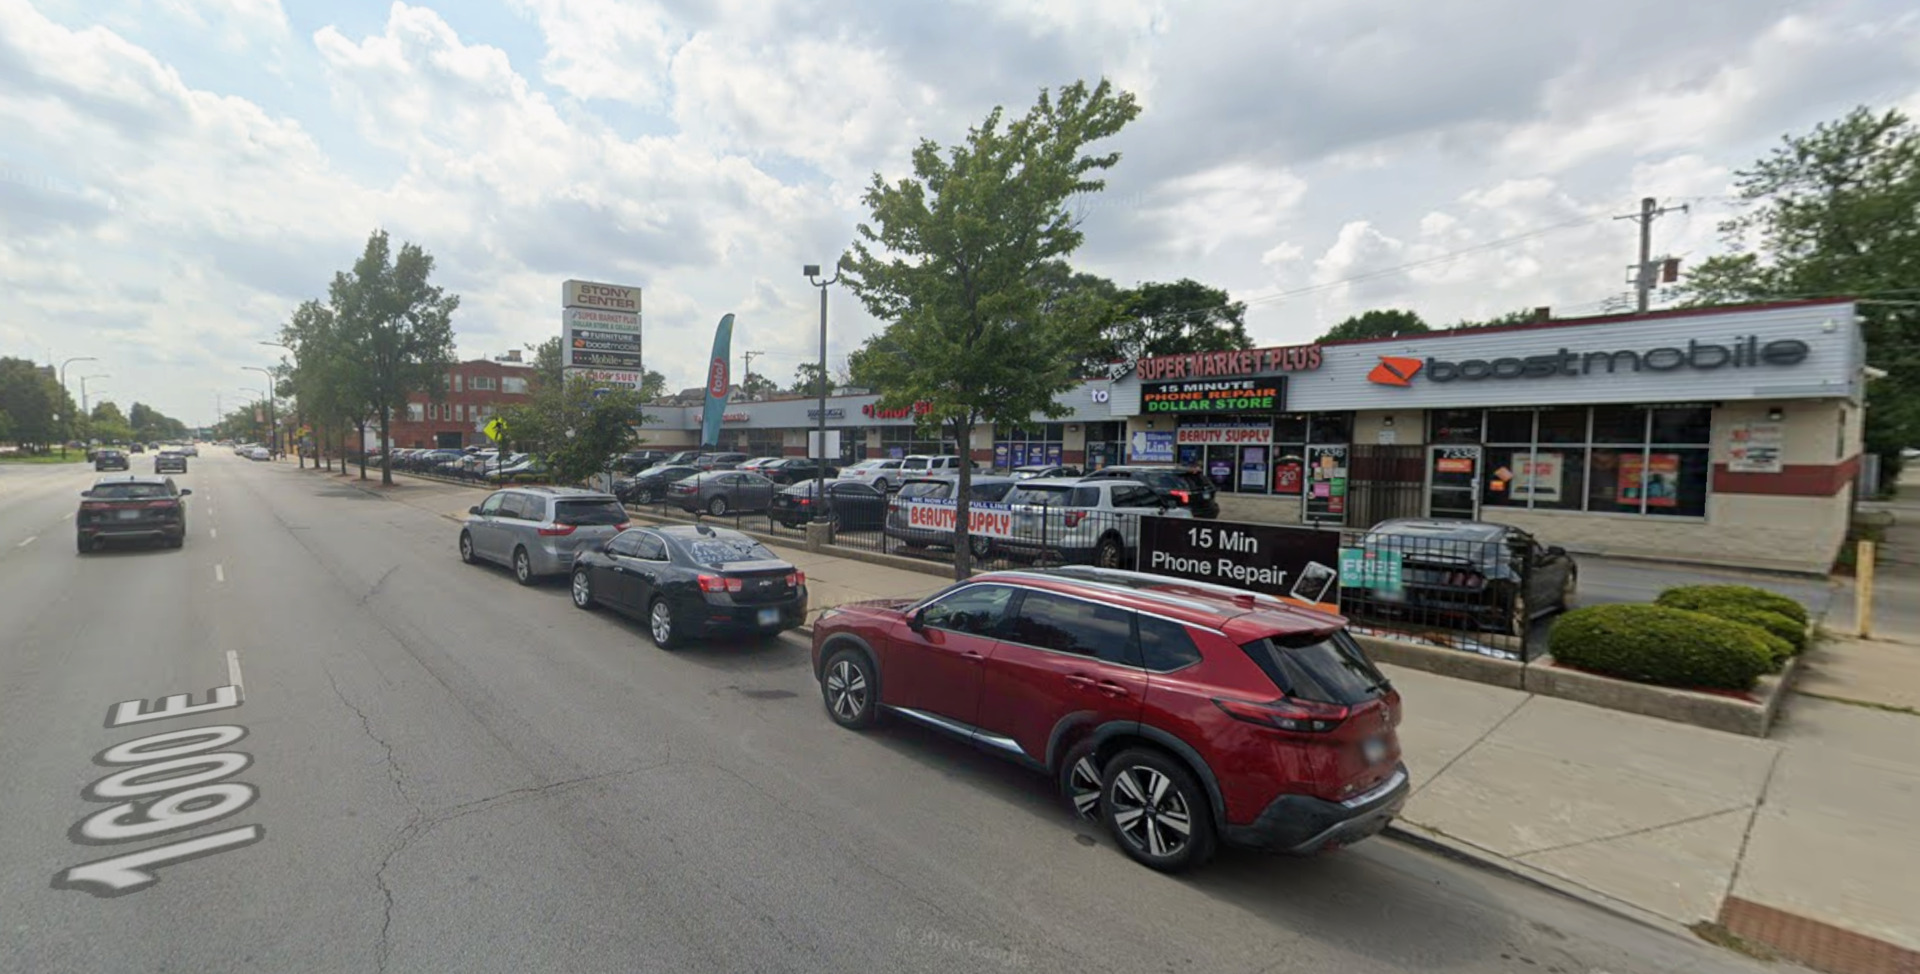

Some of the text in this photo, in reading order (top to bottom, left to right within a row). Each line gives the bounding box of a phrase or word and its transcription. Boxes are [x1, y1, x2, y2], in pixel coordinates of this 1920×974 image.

[581, 285, 631, 298] STONY
[577, 295, 635, 309] CENTER
[578, 311, 638, 325] SUPER MARKET PLUS
[591, 332, 633, 341] FURNITURE
[586, 341, 639, 351] boostmobile
[1136, 344, 1324, 380] SUPER MARKET PLUS
[1425, 335, 1811, 384] boostmobile
[615, 373, 639, 382] SUEY
[1159, 380, 1255, 393] 15 MINUTE
[1144, 388, 1277, 401] PHONE REPAIR
[1148, 397, 1273, 412] DOLLAR STORE
[1179, 428, 1270, 442] BEAUTY SUPPLY
[1146, 441, 1174, 453] Link
[969, 501, 988, 509] FULL
[911, 506, 1010, 535] BEAUTY UPPLY
[1188, 527, 1259, 553] 15 Min
[1152, 551, 1288, 585] Phone Repair
[1343, 559, 1398, 575] FREE
